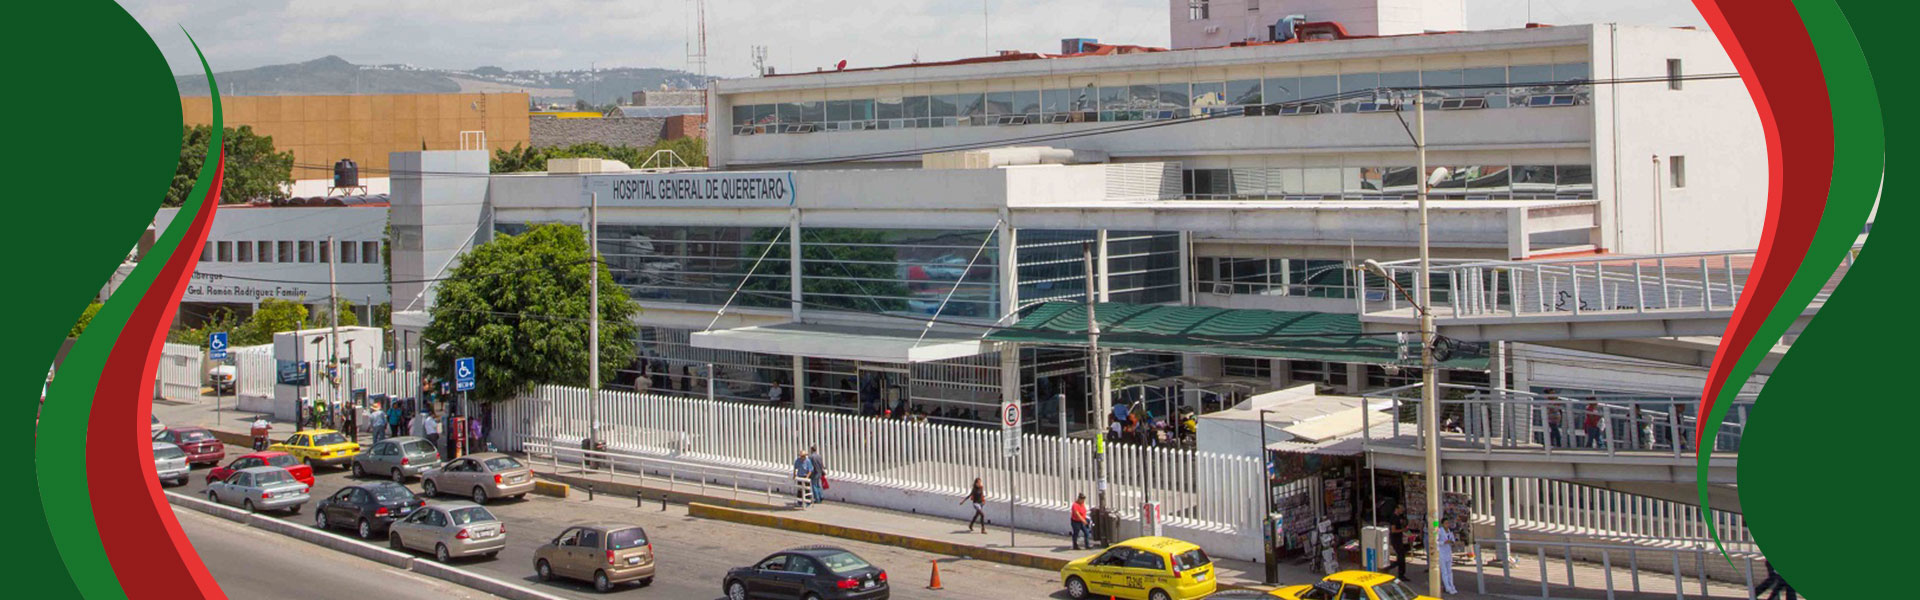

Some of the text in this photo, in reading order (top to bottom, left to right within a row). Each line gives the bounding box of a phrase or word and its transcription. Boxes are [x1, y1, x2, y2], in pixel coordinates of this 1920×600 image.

[613, 179, 656, 200] HOSPITAL
[658, 179, 703, 200] GENERAL
[706, 179, 719, 199] DE
[1008, 408, 1016, 422] E
